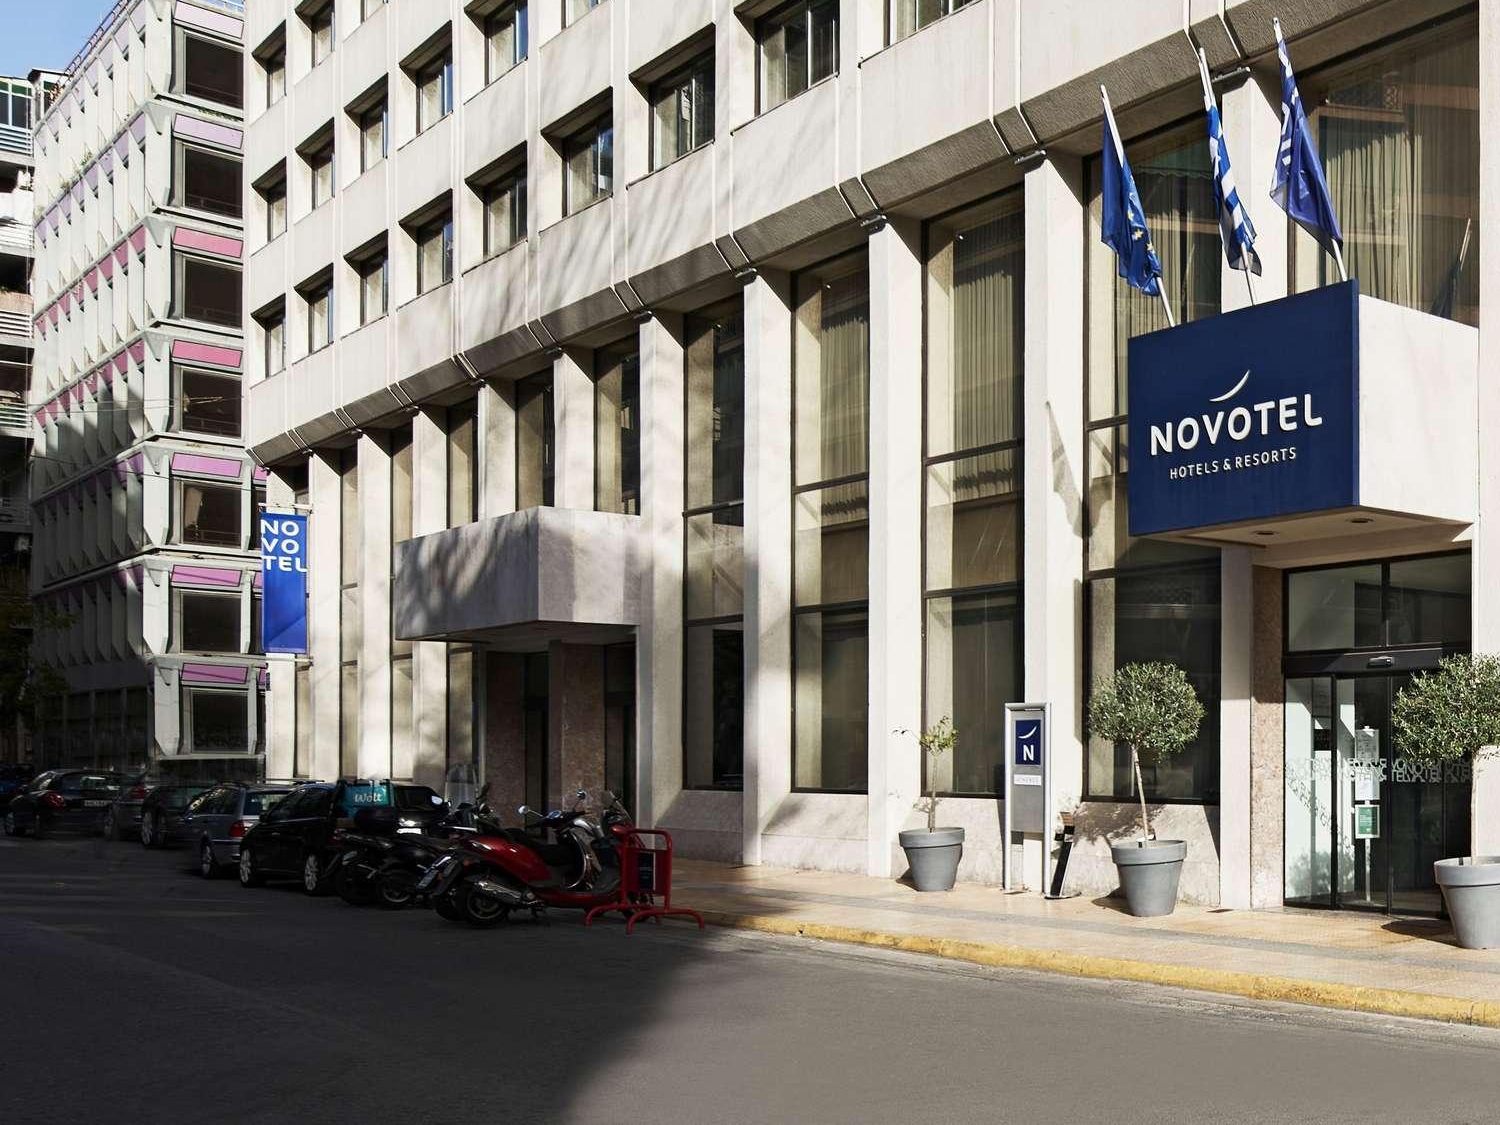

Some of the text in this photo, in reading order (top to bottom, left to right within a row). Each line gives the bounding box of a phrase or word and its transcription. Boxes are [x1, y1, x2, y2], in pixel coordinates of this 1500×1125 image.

[1150, 394, 1323, 456] NOVOTEL
[1169, 446, 1297, 480] HOTELS & RESORTS
[261, 519, 300, 536] NO
[261, 537, 300, 555] VO
[262, 555, 308, 572] TEL
[1023, 744, 1034, 761] N
[354, 793, 382, 803] Wolt
